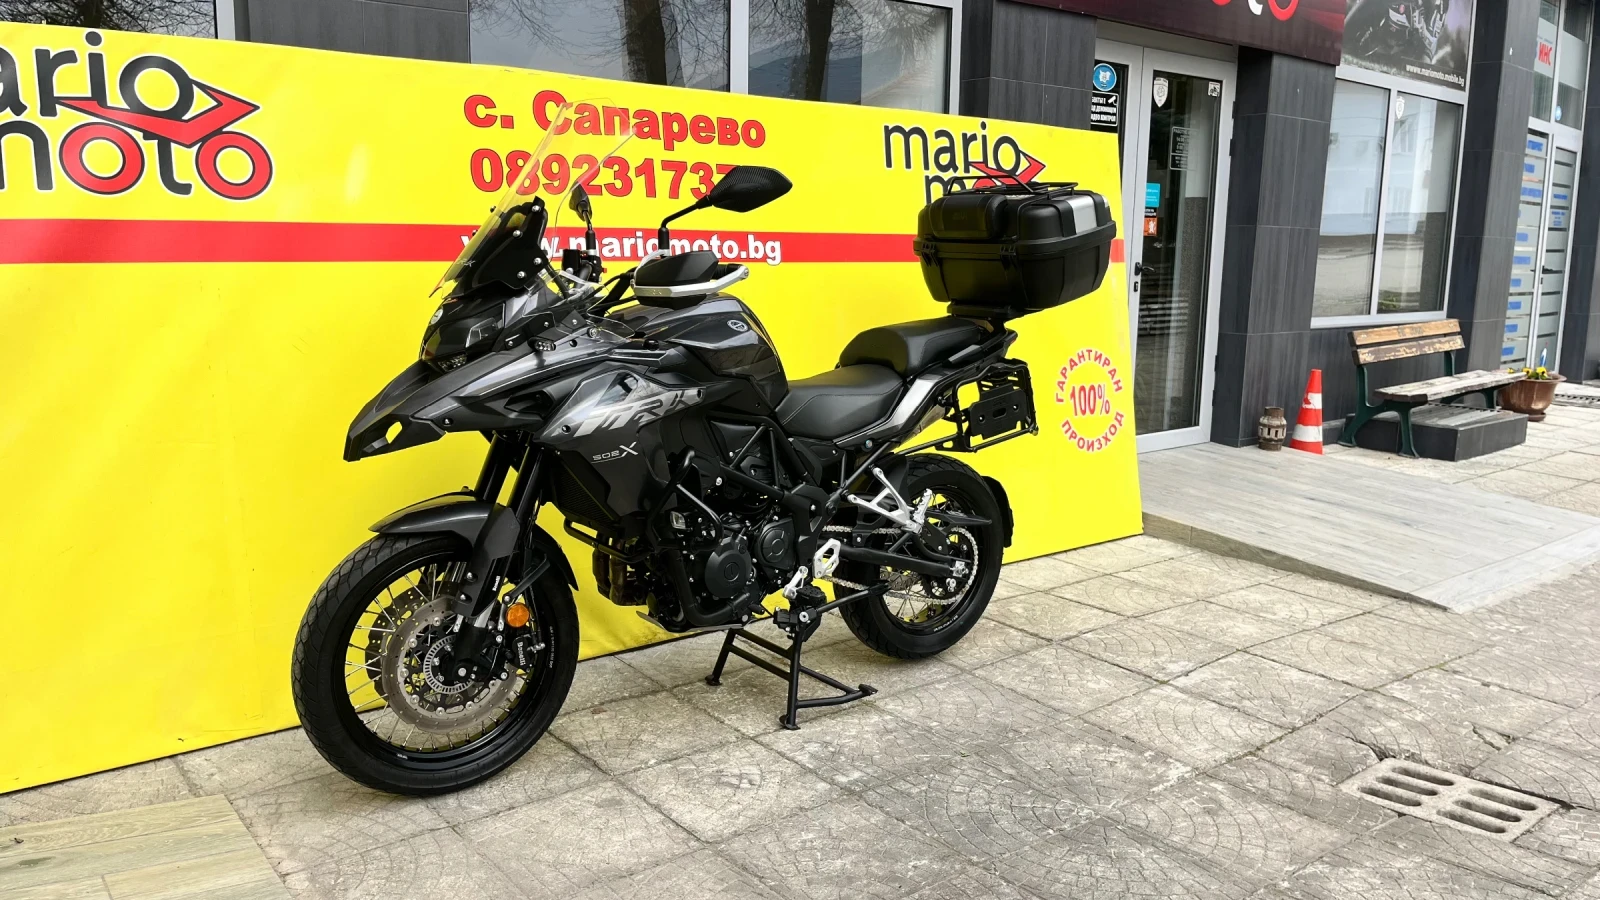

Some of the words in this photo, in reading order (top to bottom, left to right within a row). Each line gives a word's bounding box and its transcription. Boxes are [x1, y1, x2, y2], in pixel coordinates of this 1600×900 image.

[464, 94, 515, 129] с.
[532, 89, 767, 151] Сапарево
[883, 121, 1021, 175] mario
[1056, 349, 1123, 403] ГАРАНТИРАН
[1070, 384, 1110, 416] 100%
[1061, 411, 1124, 452] ПРОИЗХОД
[516, 641, 527, 666] Benelli
